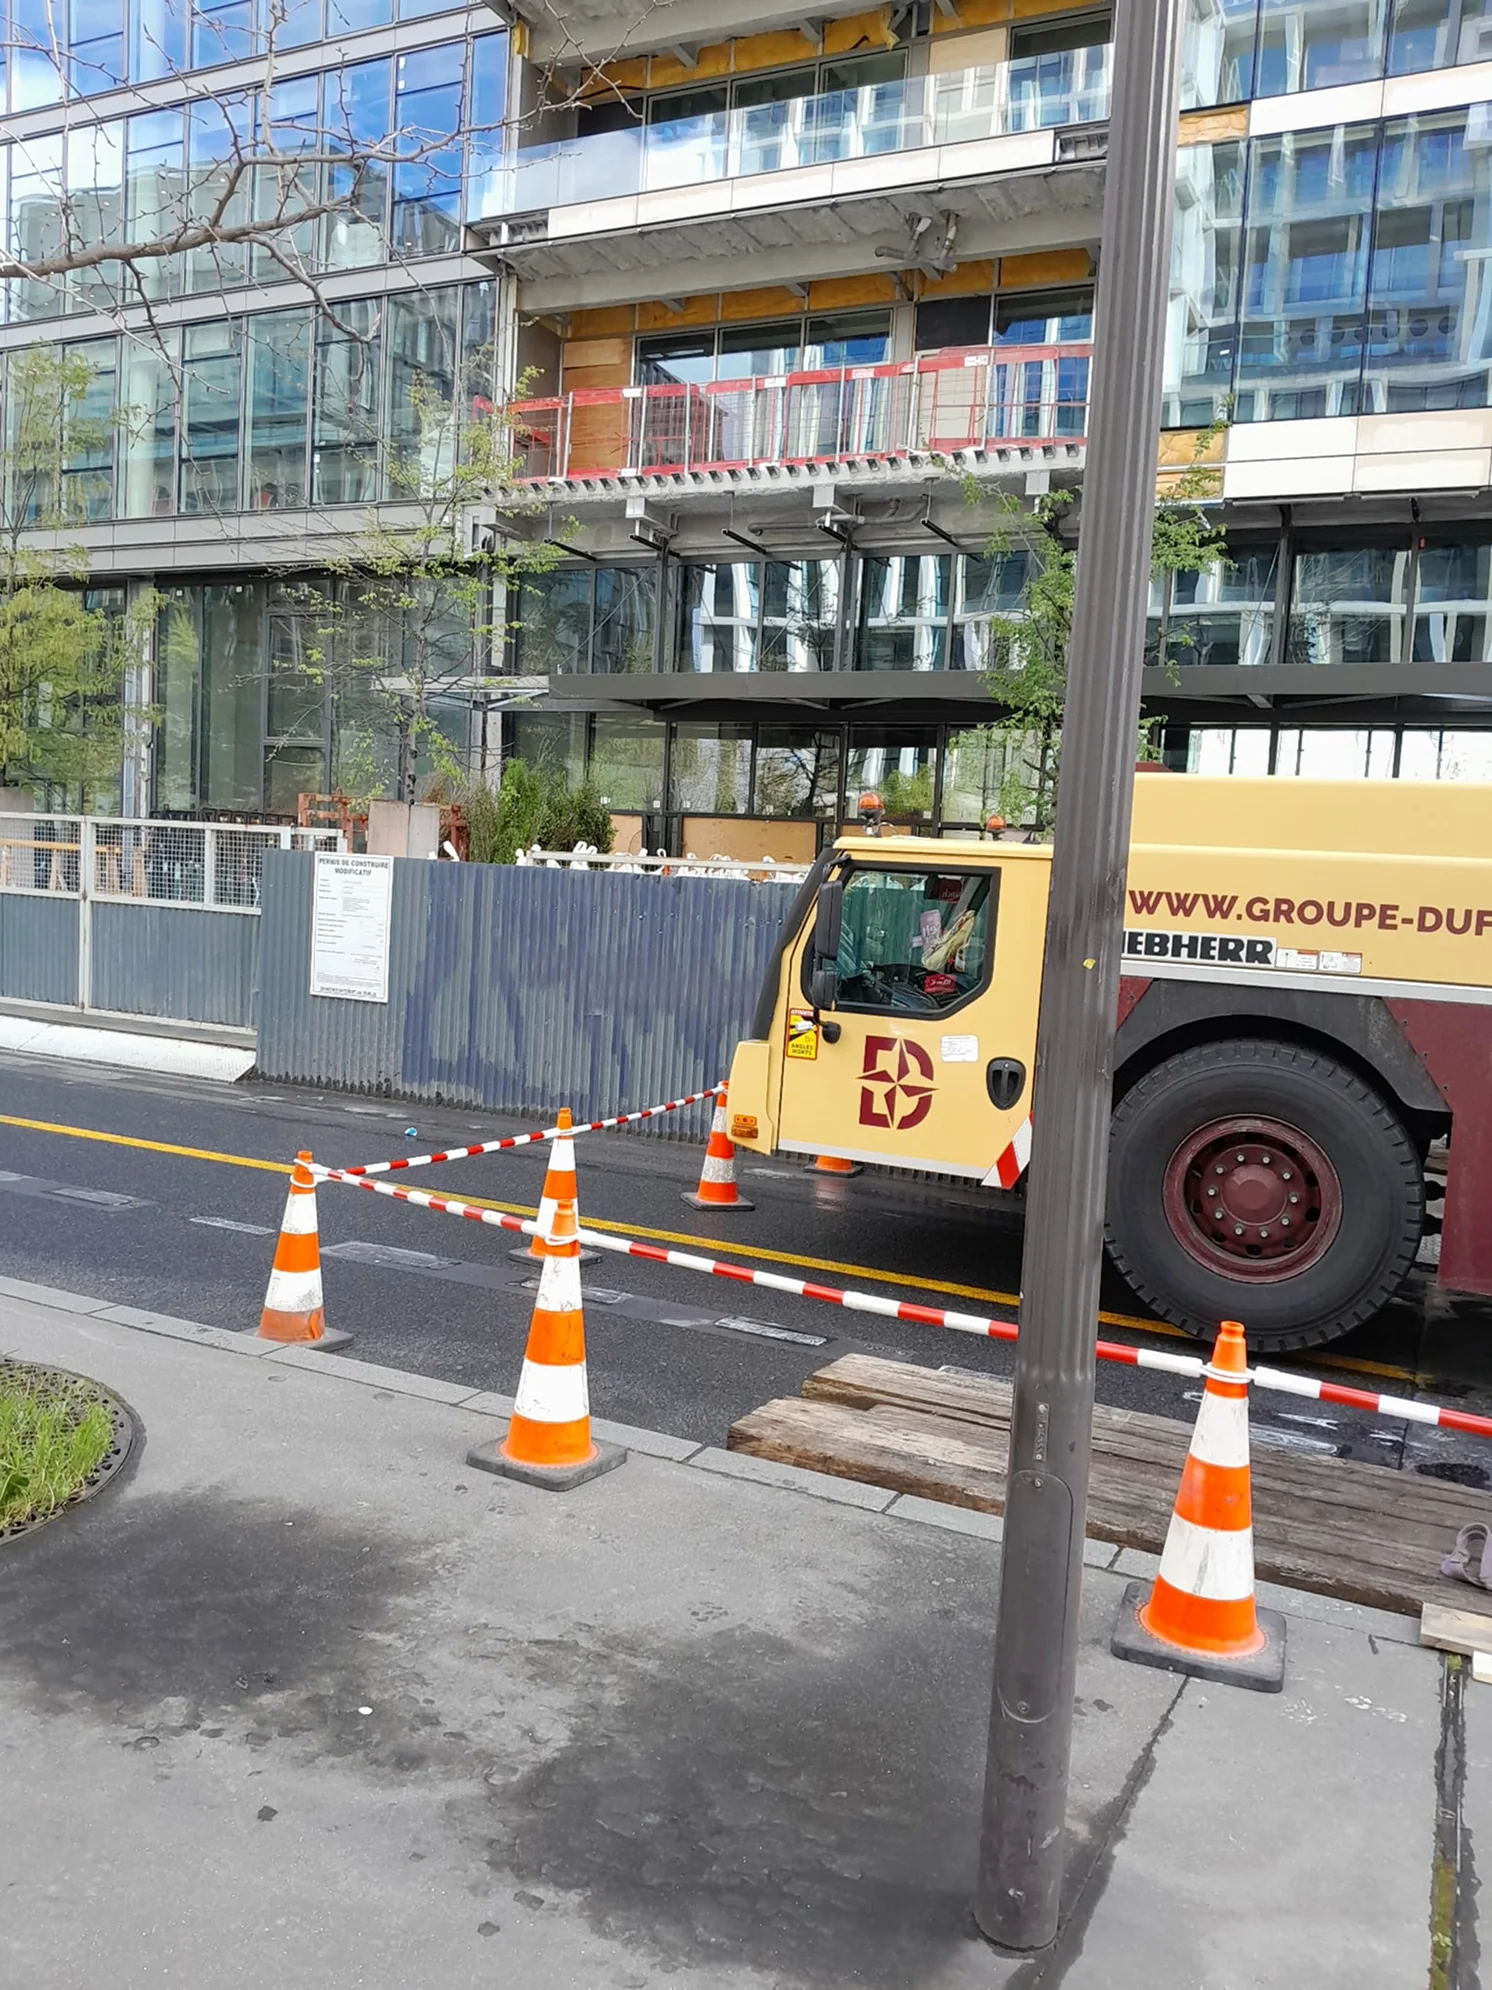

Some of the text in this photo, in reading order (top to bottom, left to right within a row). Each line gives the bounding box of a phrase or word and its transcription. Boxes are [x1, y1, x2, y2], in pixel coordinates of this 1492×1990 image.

[350, 860, 388, 869] CONSTRUIRE
[334, 867, 372, 876] MODIFICATIF
[791, 1043, 813, 1051] ANGLES
